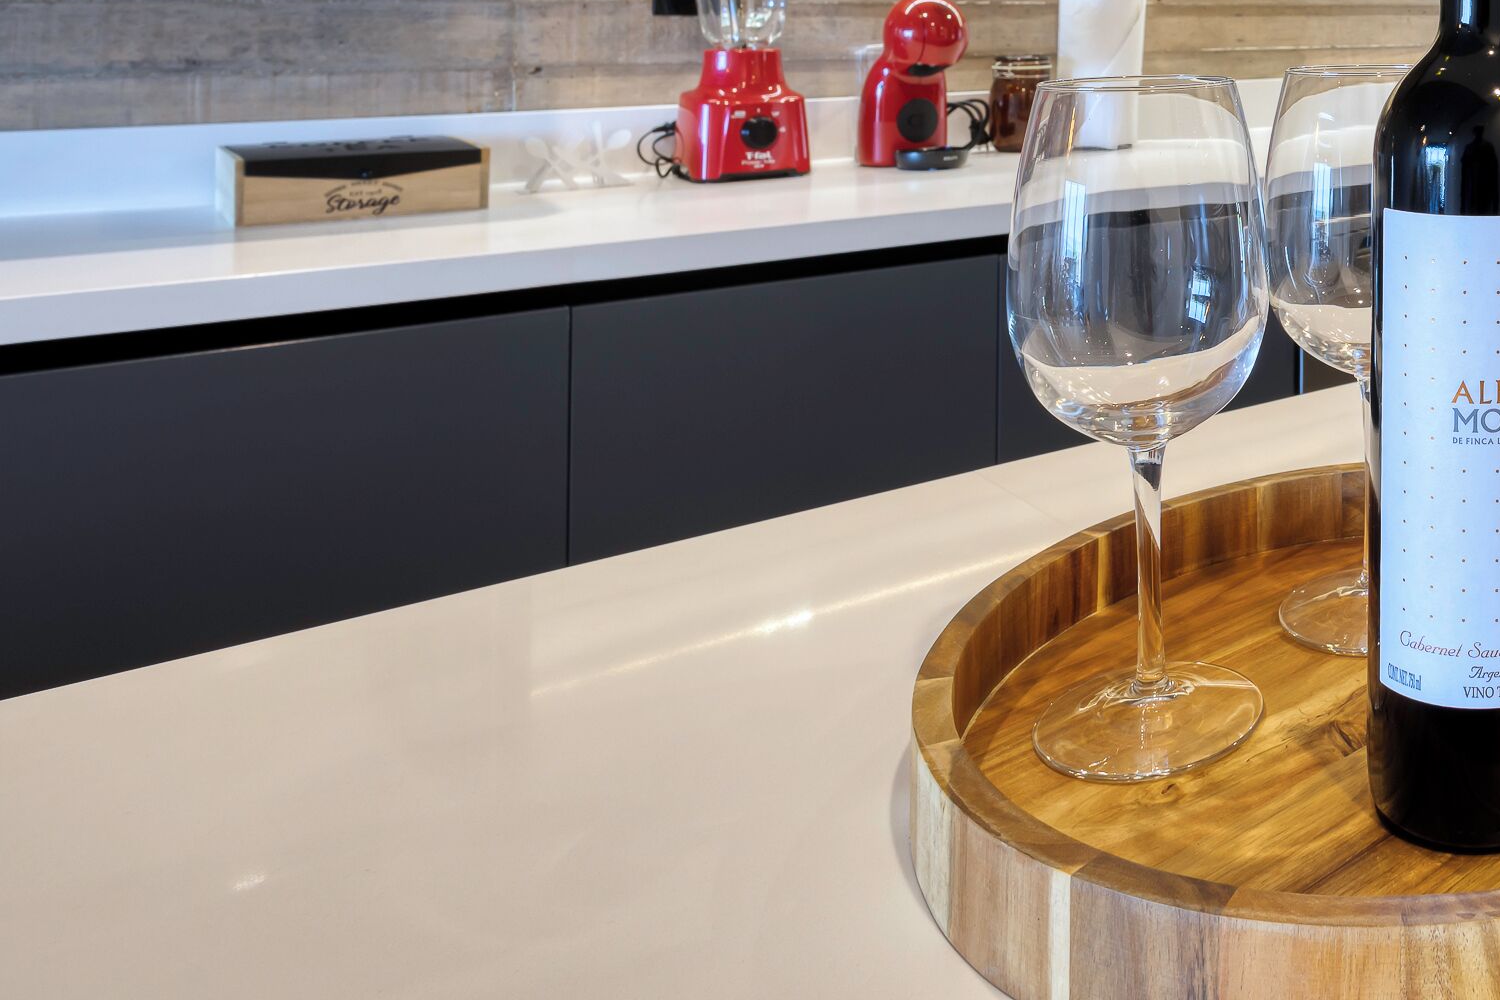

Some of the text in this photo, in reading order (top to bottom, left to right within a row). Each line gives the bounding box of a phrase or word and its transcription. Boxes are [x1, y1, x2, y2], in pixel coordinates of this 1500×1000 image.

[325, 194, 400, 216] Storage
[1452, 436, 1463, 444] DE
[1465, 436, 1495, 446] FINCA
[1400, 630, 1463, 657] Cabernet
[1463, 686, 1495, 699] VINO
